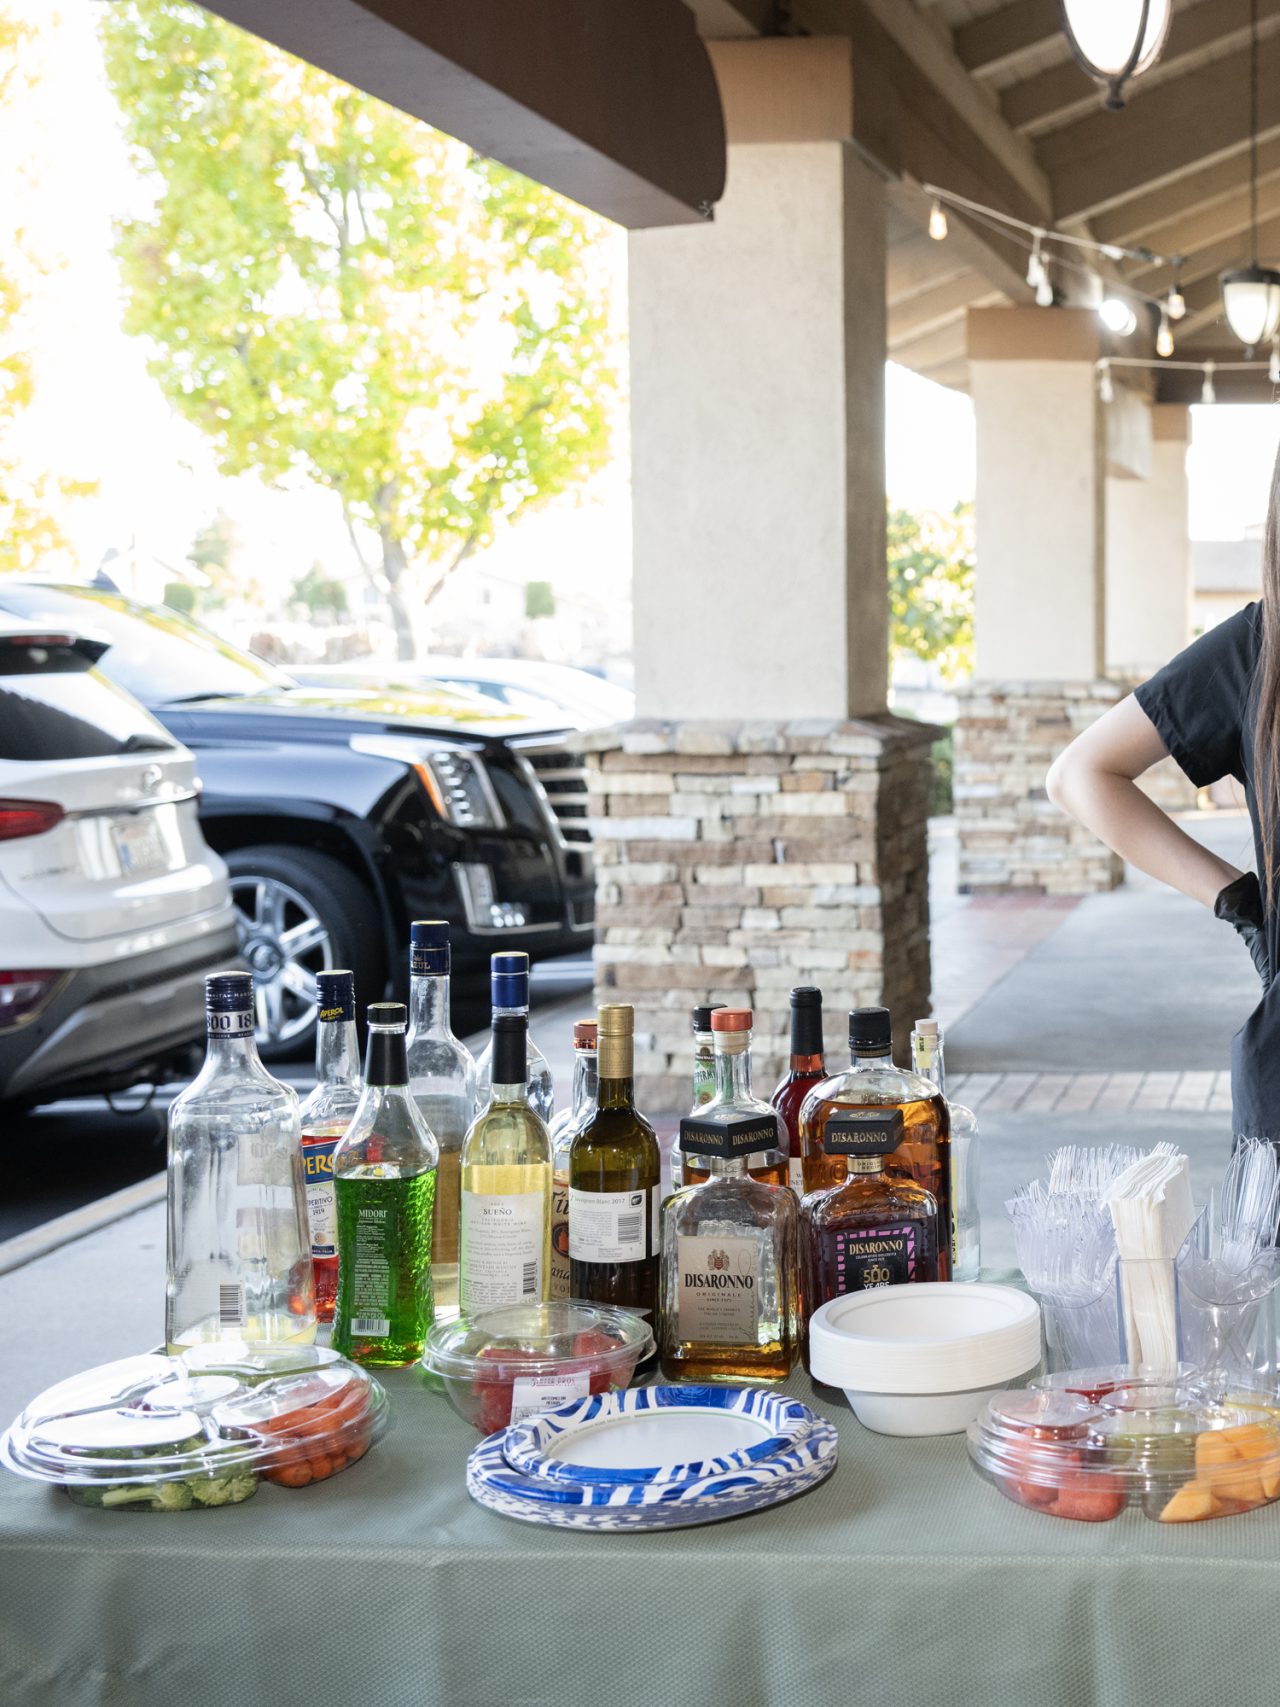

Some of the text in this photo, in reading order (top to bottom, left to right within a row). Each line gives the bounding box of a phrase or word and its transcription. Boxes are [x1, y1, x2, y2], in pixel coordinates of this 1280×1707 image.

[320, 1007, 344, 1018] APEROL
[684, 1129, 724, 1146] DISARONNO
[732, 1127, 774, 1146] DISARONNO
[831, 1131, 888, 1143] DISARONNO
[482, 1207, 513, 1216] SUEÑO
[849, 1240, 903, 1255] DISARONNO
[685, 1273, 754, 1290] DISARONNO
